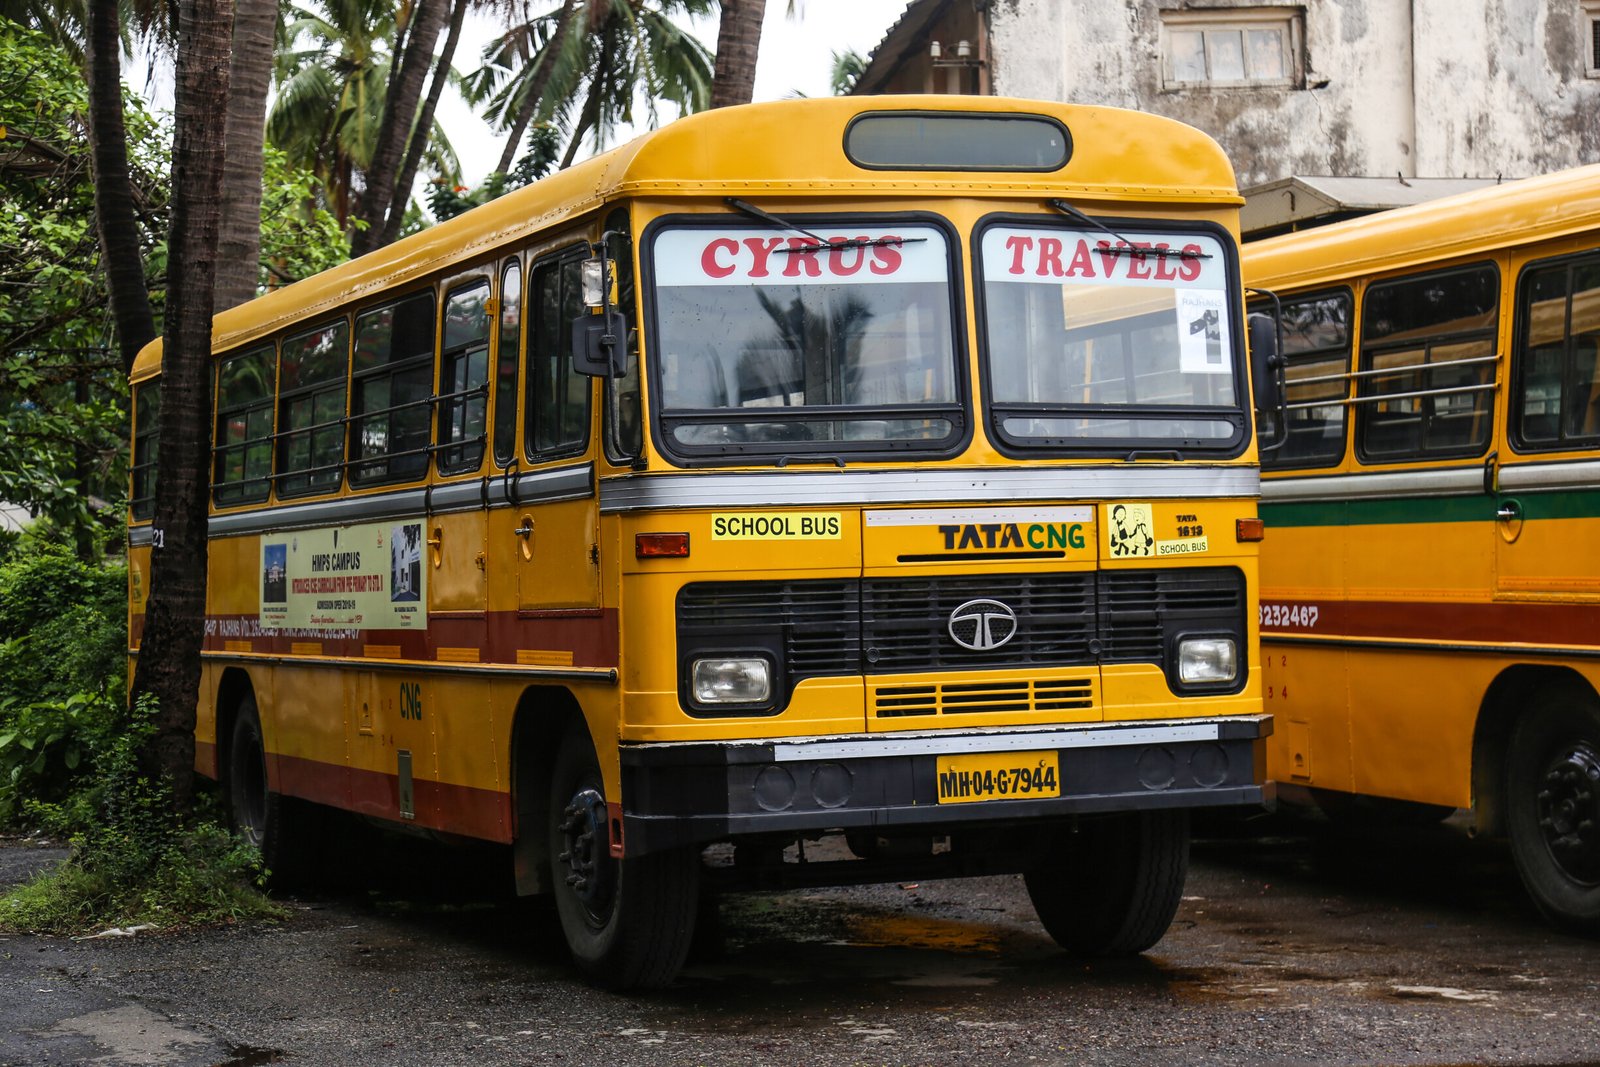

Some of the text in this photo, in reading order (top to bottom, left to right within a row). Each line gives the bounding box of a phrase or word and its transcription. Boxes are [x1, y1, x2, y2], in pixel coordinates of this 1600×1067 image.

[701, 236, 904, 279] CYRUS
[1006, 236, 1203, 282] TRAVELS
[1189, 309, 1222, 364] 1
[715, 514, 797, 538] SCHOOL
[802, 513, 840, 537] BUS
[1176, 514, 1197, 522] TATA
[939, 523, 1086, 550] TATA CNG
[1160, 542, 1206, 554] SCHOOL BUS
[312, 552, 360, 571] HMPS CAMPUS
[400, 682, 422, 720] CNG
